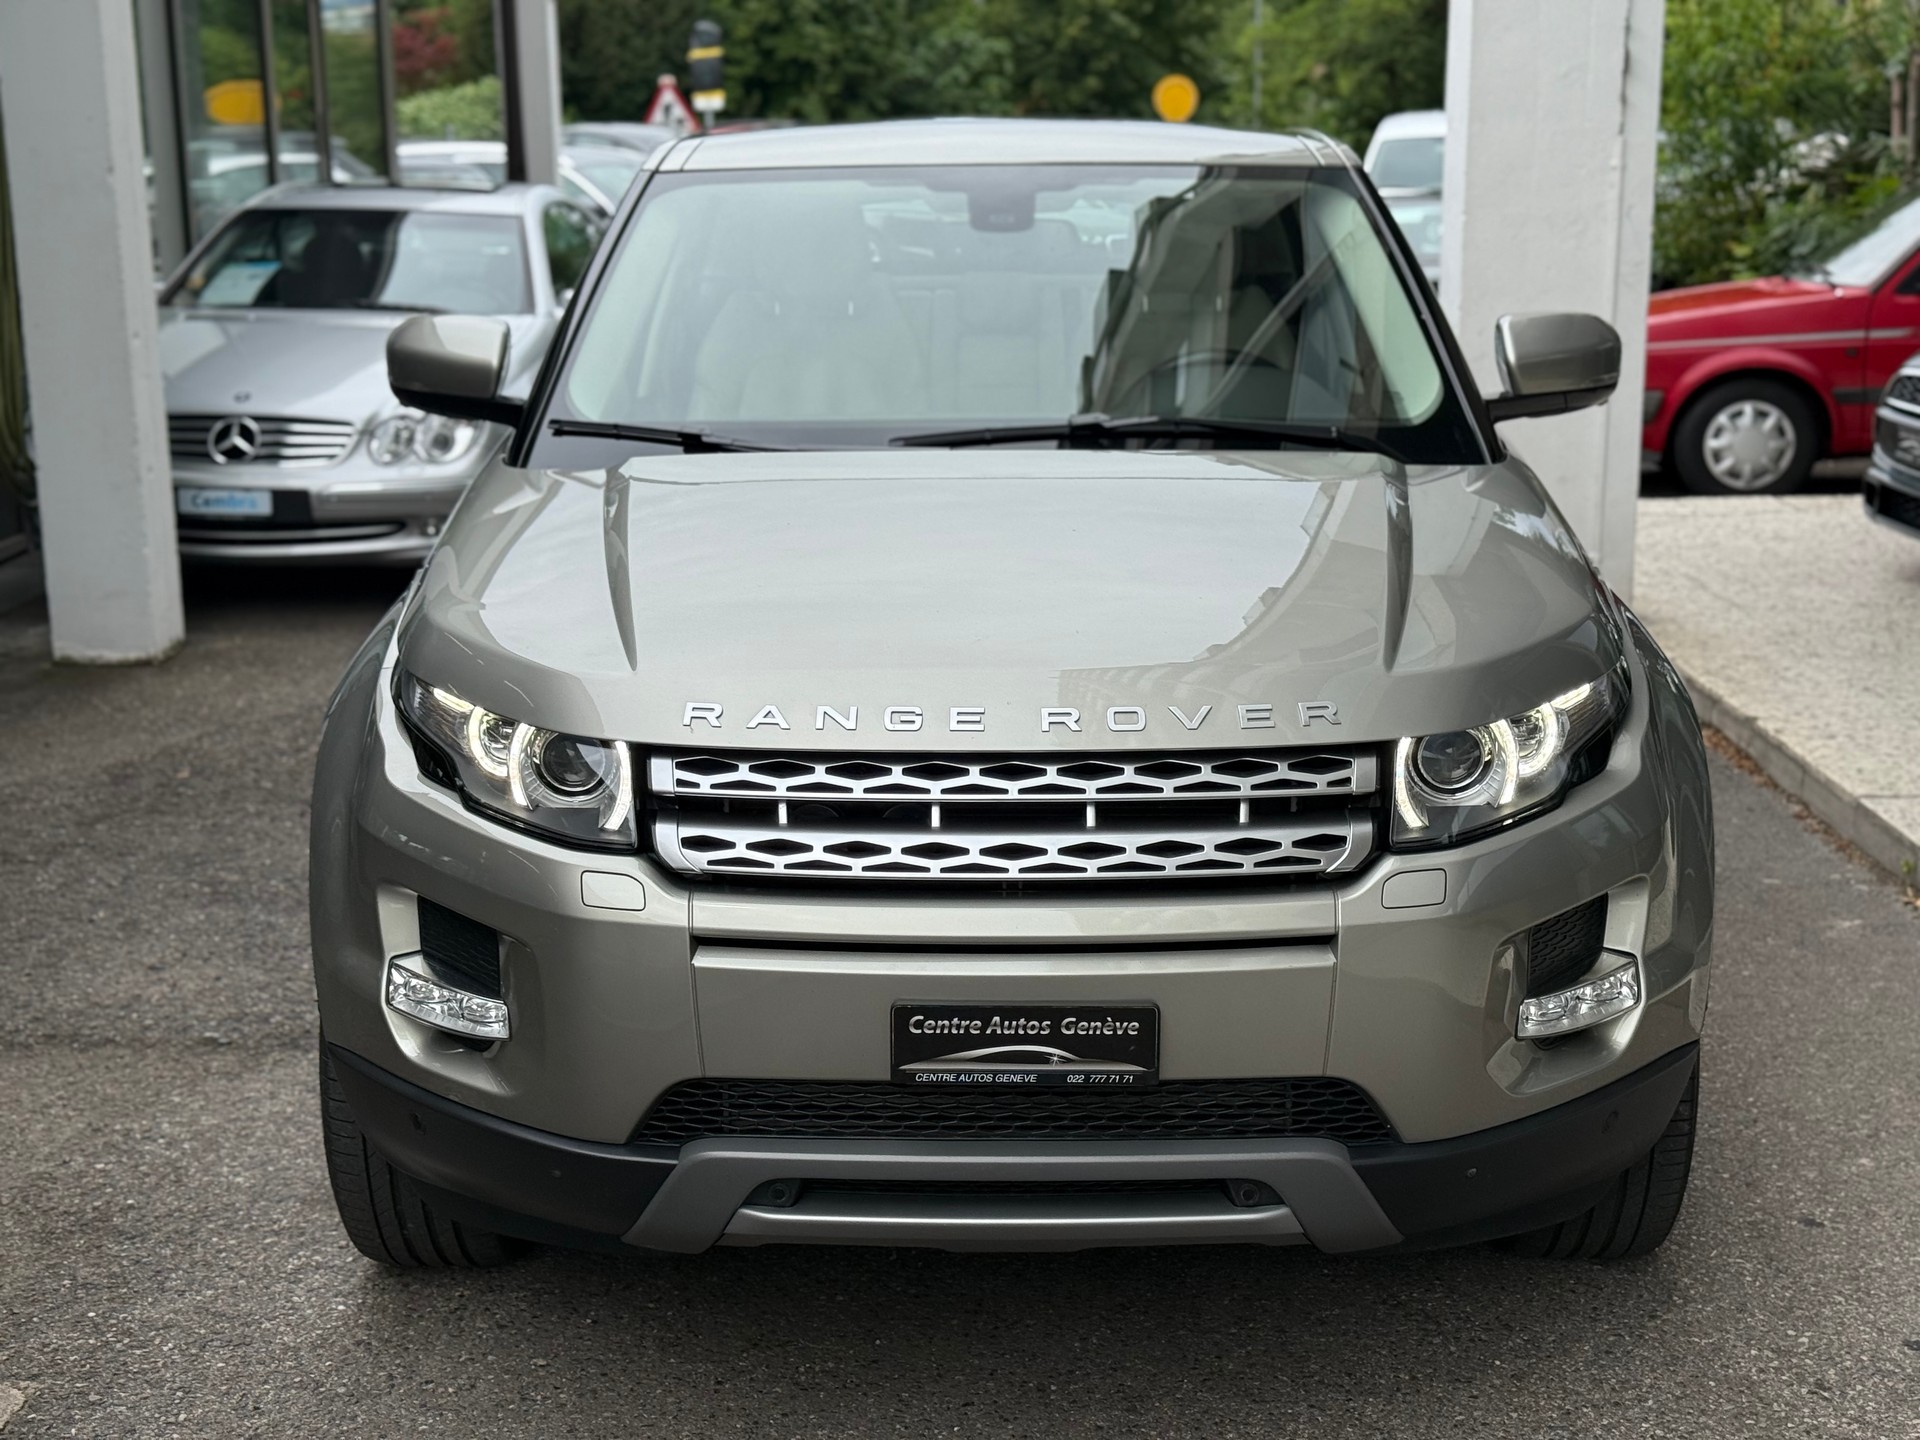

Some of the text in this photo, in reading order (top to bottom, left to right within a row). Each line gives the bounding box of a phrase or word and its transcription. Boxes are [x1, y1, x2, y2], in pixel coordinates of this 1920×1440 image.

[682, 701, 1342, 732] RANGE ROVER
[908, 1015, 1140, 1035] Centre Autos Genève
[915, 1073, 1134, 1083] CENTRE AUTOS GENEVE 022 777 71 71
